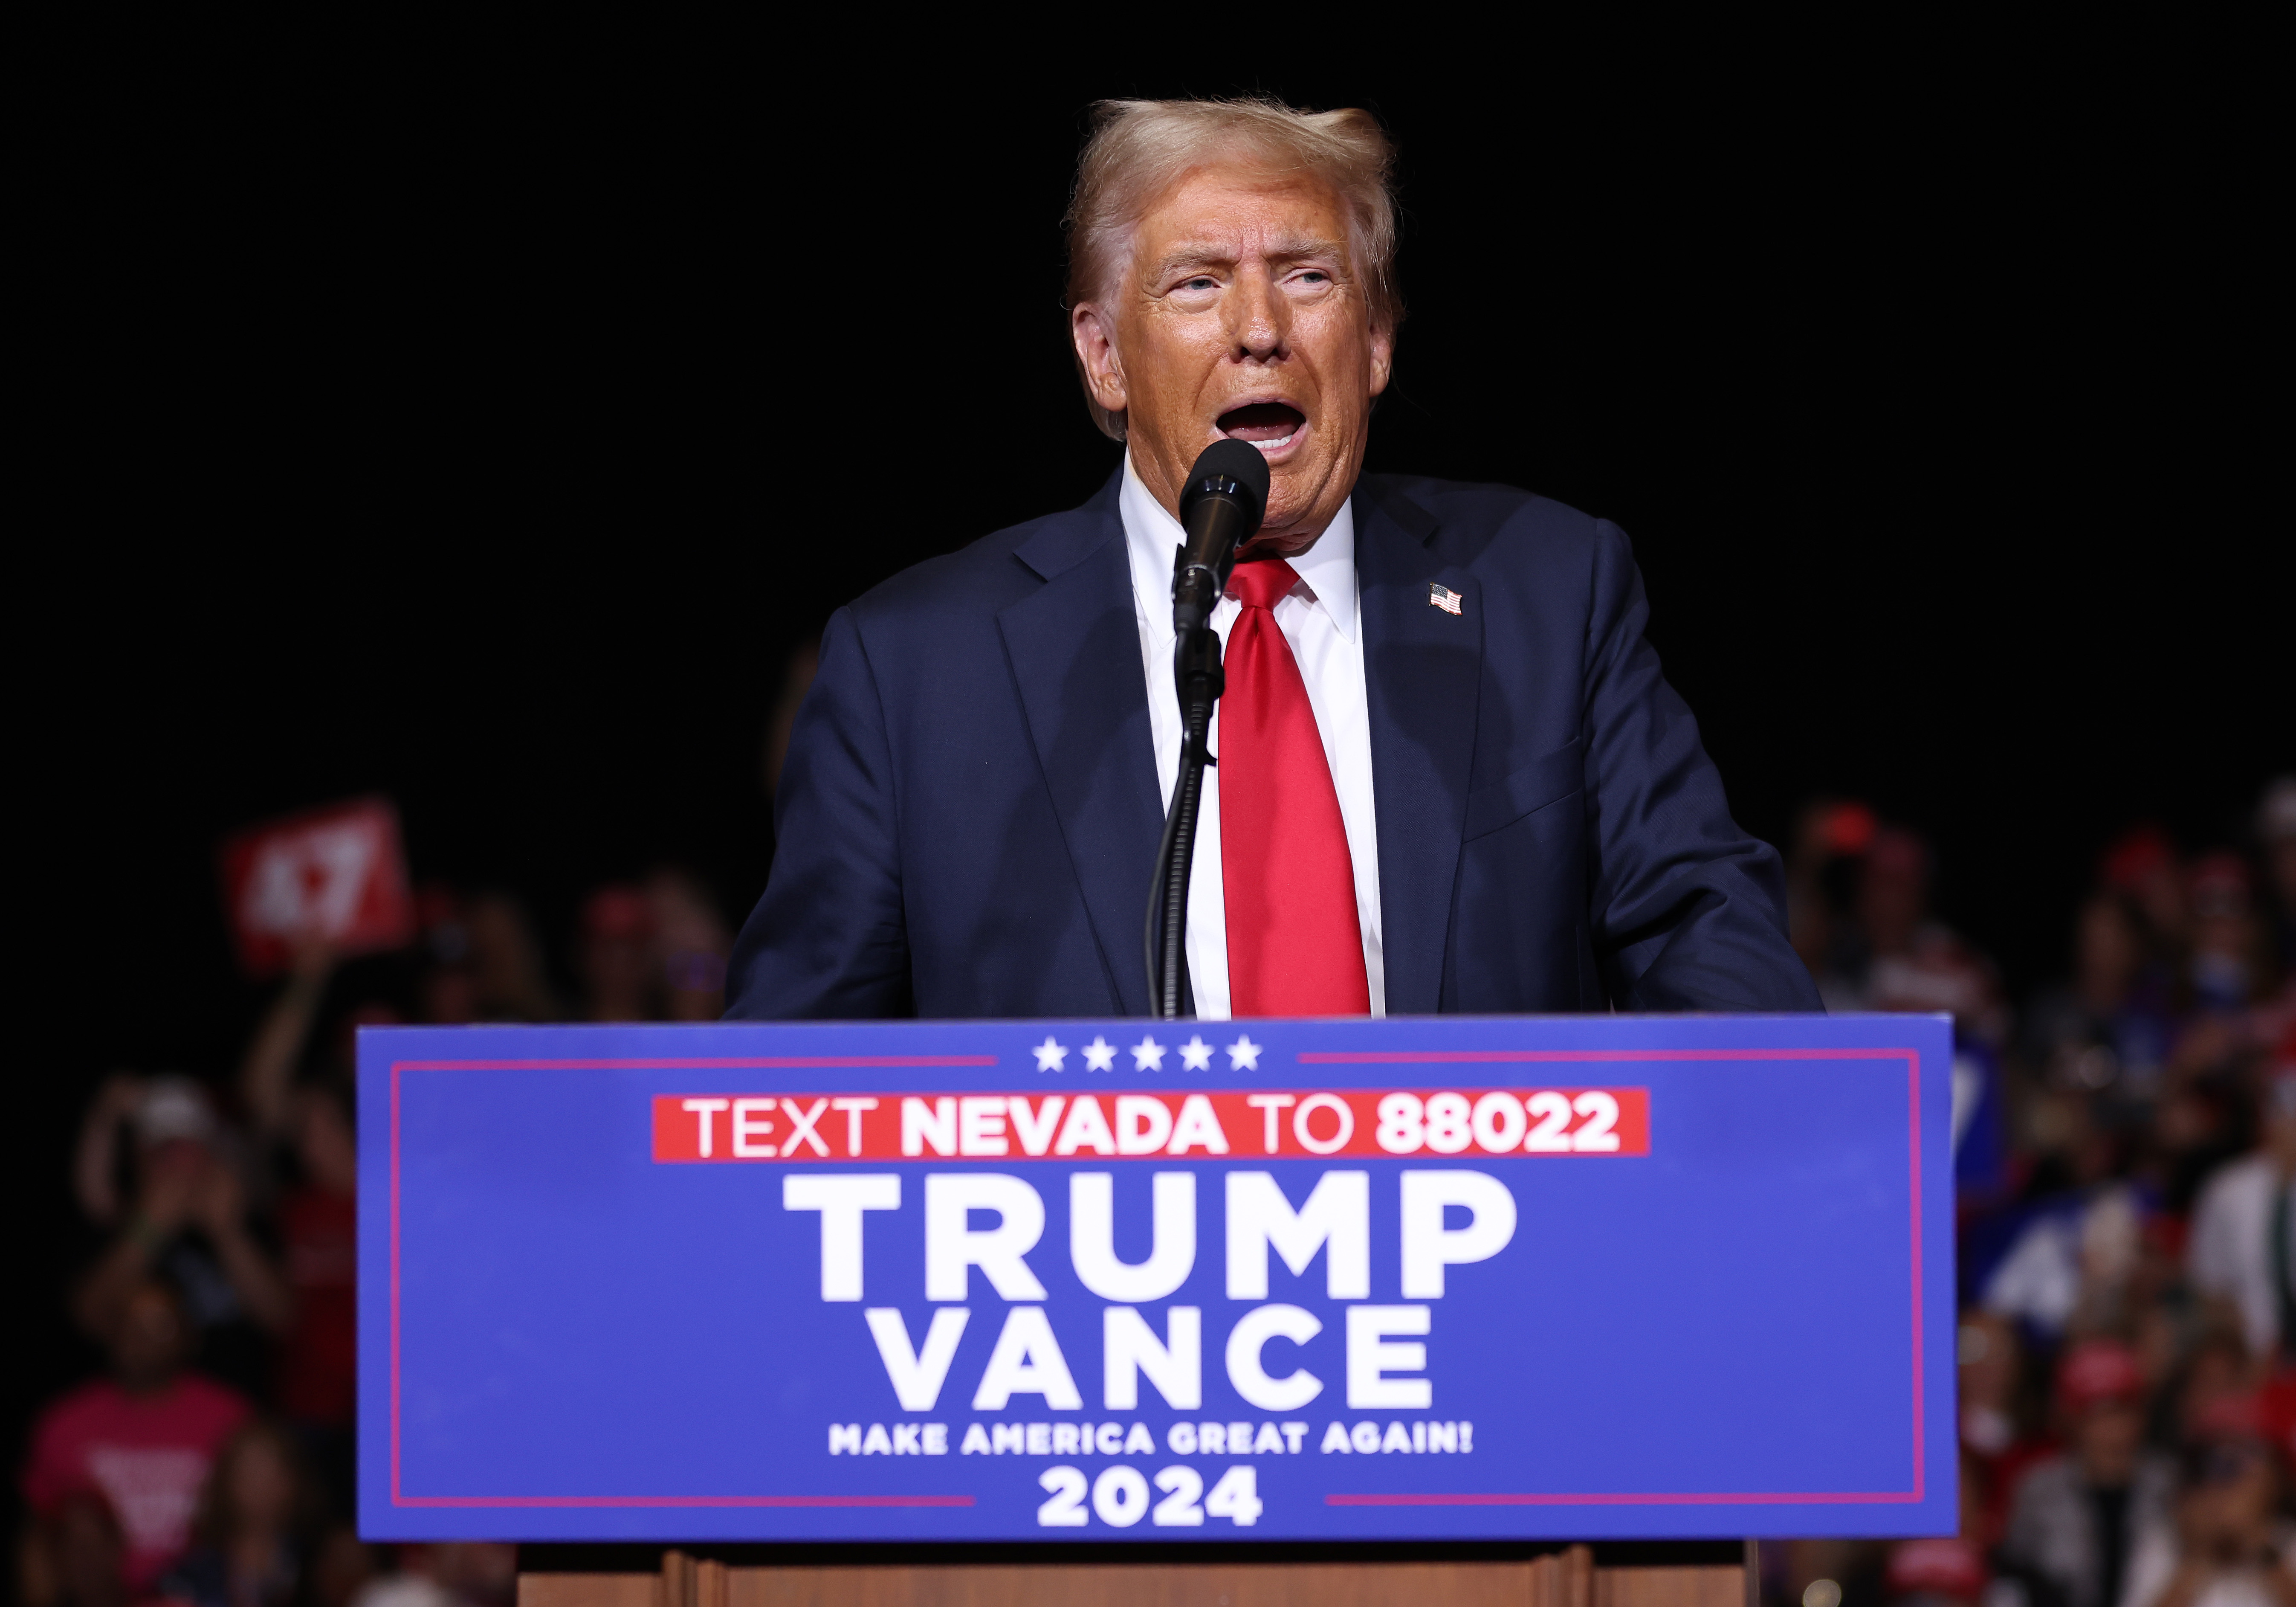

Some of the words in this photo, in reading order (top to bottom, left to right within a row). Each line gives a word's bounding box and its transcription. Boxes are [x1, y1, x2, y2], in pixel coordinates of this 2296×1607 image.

[682, 1097, 878, 1158] TEXT
[901, 1094, 1229, 1157] NEVADA
[1247, 1093, 1354, 1155] TO
[1376, 1091, 1620, 1154] 88022
[782, 1169, 1517, 1303] TRUMP
[864, 1303, 1433, 1412] VANCE
[828, 1423, 948, 1456] MAKE
[961, 1422, 1155, 1456] AMERICA
[1167, 1421, 1309, 1455] GREAT
[1320, 1421, 1473, 1455] AGAIN!
[1037, 1465, 1263, 1528] 2024
